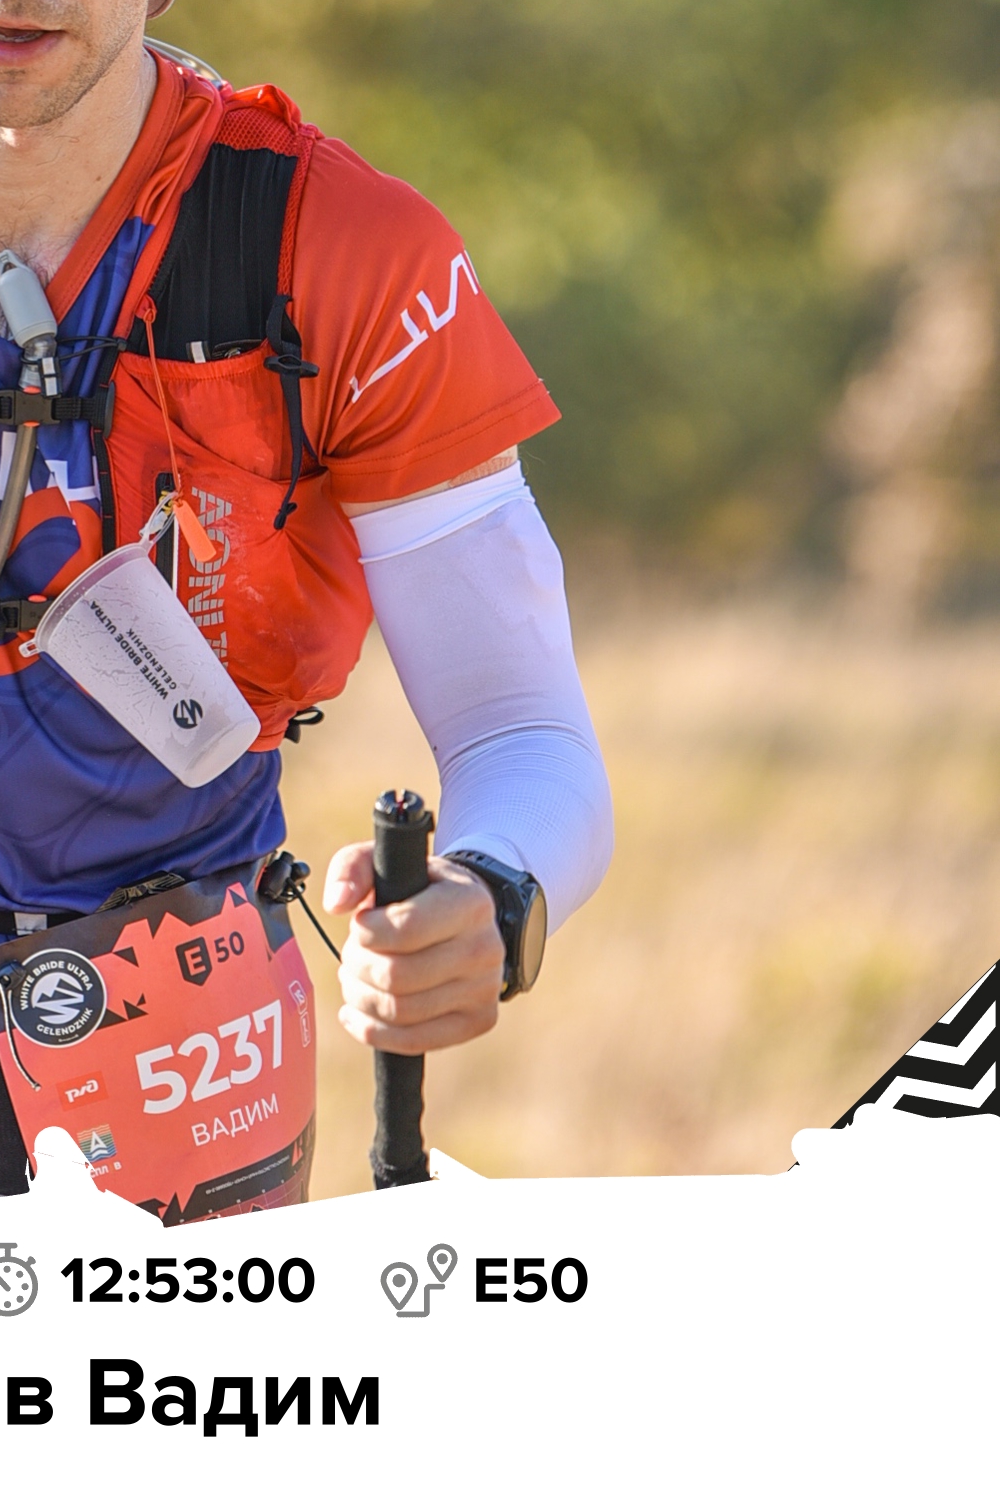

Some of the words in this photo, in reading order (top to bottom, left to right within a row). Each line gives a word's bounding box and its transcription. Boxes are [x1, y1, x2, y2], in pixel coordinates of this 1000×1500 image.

[90, 600, 117, 635] ULTRA
[115, 633, 143, 666] BRIDE
[126, 628, 177, 690] GELENDZHIK
[140, 665, 169, 700] WHITE
[213, 930, 246, 964] 50
[20, 975, 36, 1011] WHITE
[32, 960, 66, 977] BRIDE
[66, 962, 94, 992] ULTRA
[36, 1007, 94, 1037] GELENDZHIK
[135, 999, 283, 1114] 5237
[191, 1092, 281, 1147] ВАДИМ
